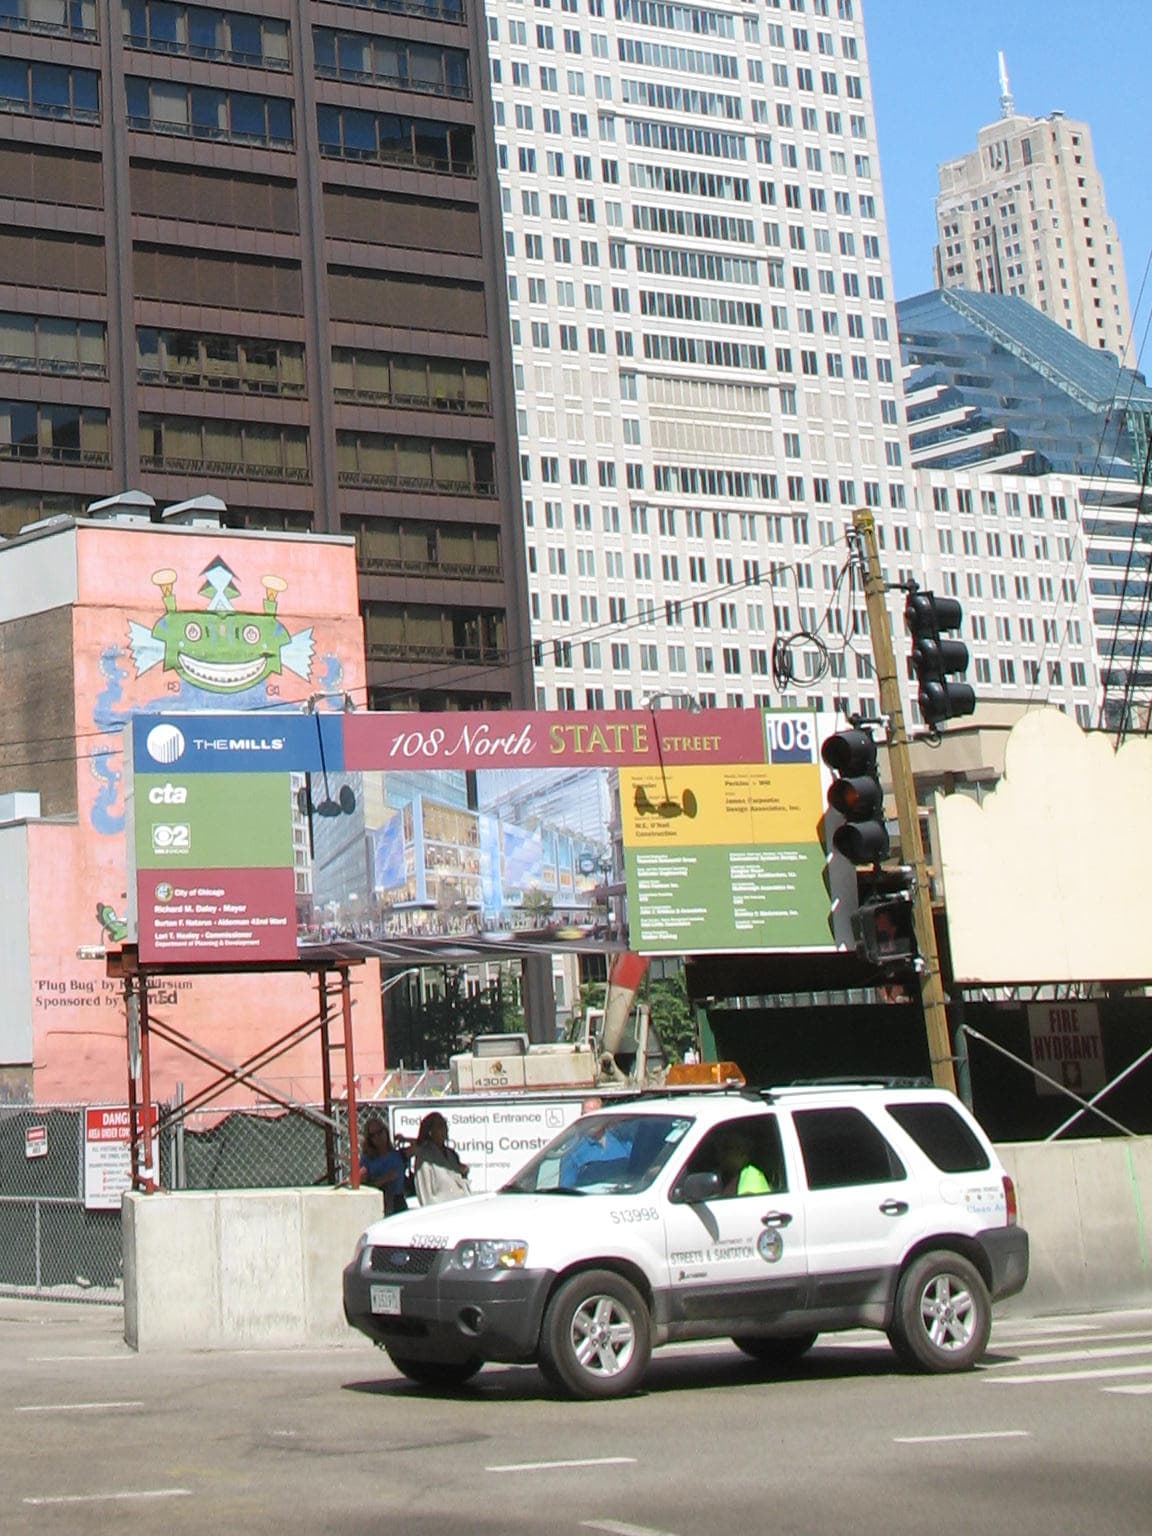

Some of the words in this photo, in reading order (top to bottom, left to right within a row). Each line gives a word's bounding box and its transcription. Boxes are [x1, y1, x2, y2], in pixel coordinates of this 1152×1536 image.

[389, 728, 445, 757] 108
[444, 723, 537, 756] North
[549, 723, 649, 754] STATE
[662, 735, 722, 752] STREET
[148, 783, 188, 804] cta
[172, 825, 189, 846] 2
[174, 888, 188, 898] City
[189, 888, 197, 897] of
[197, 888, 225, 897] Chicago
[154, 904, 183, 913] Richard
[184, 904, 194, 913] M.
[195, 904, 218, 914] Daley
[223, 904, 247, 914] Mayor
[101, 980, 115, 992] by
[35, 995, 99, 1010] Sponsored
[105, 995, 119, 1007] by
[1049, 1008, 1080, 1033] FIRE
[1033, 1034, 1100, 1061] HYDRANT
[475, 1076, 509, 1086] 4300
[452, 1114, 490, 1125] Station
[493, 1112, 542, 1124] Entrance
[610, 1207, 660, 1225] S13998
[670, 1249, 704, 1266] STREETS
[714, 1245, 755, 1262] SANITATION
